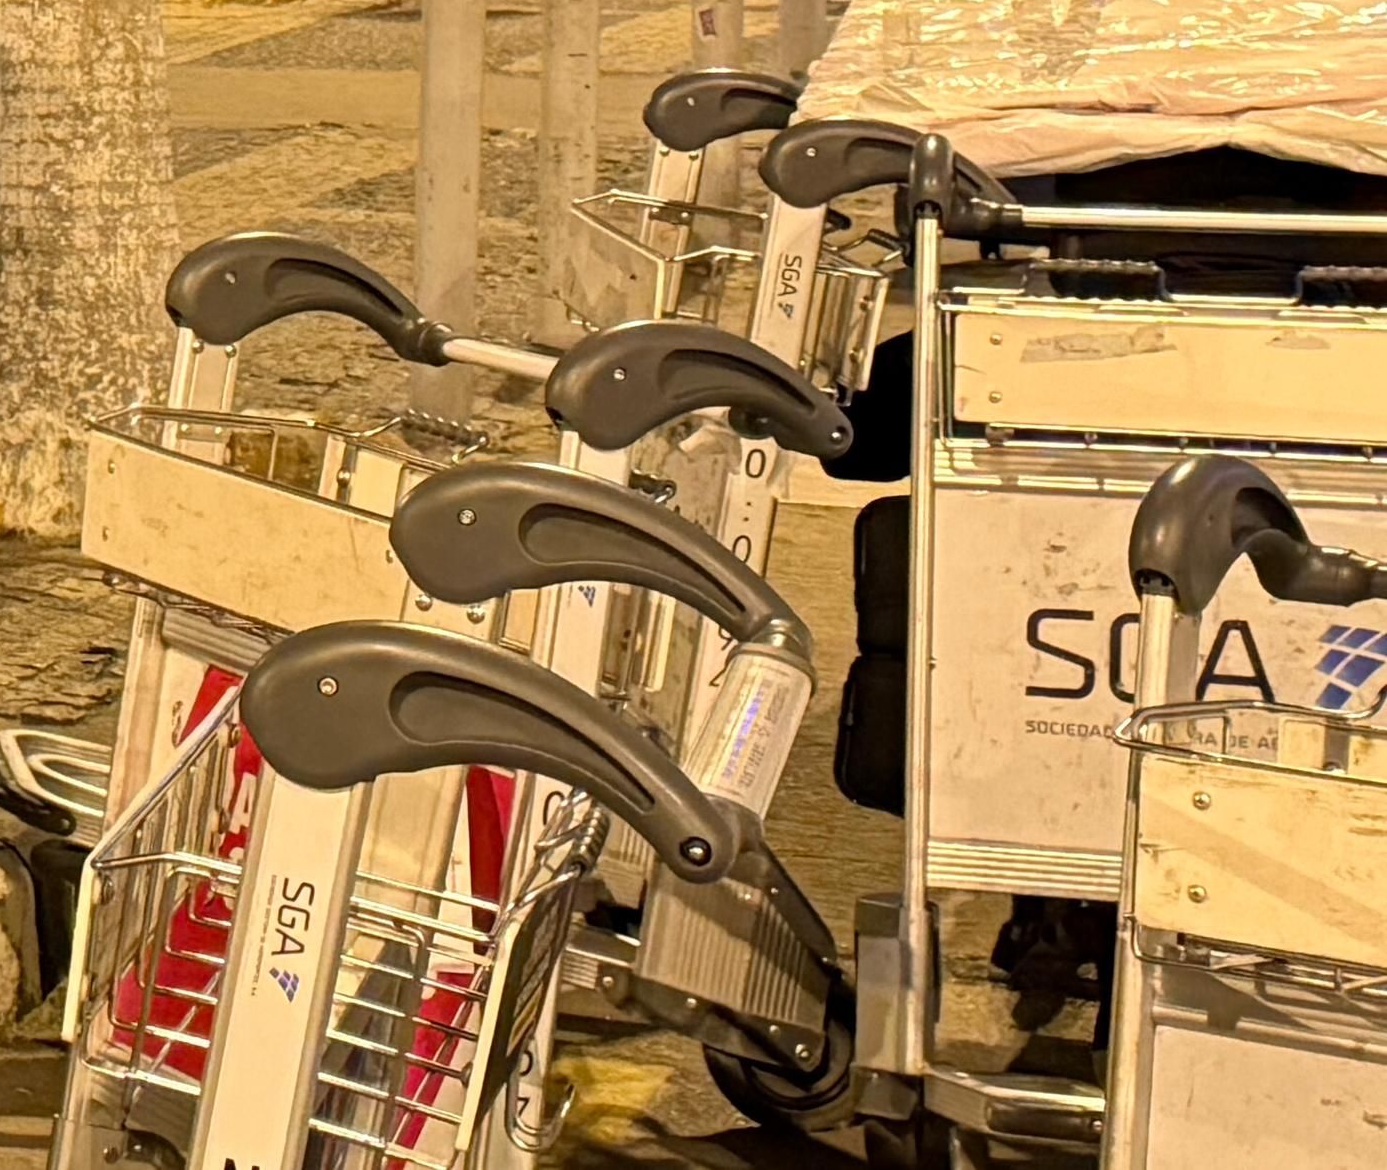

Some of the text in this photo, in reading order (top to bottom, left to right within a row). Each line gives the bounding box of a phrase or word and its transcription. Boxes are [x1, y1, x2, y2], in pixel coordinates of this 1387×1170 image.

[777, 253, 803, 298] SGA
[1024, 719, 1115, 739] SOCIEDAD
[270, 877, 316, 956] SGA
